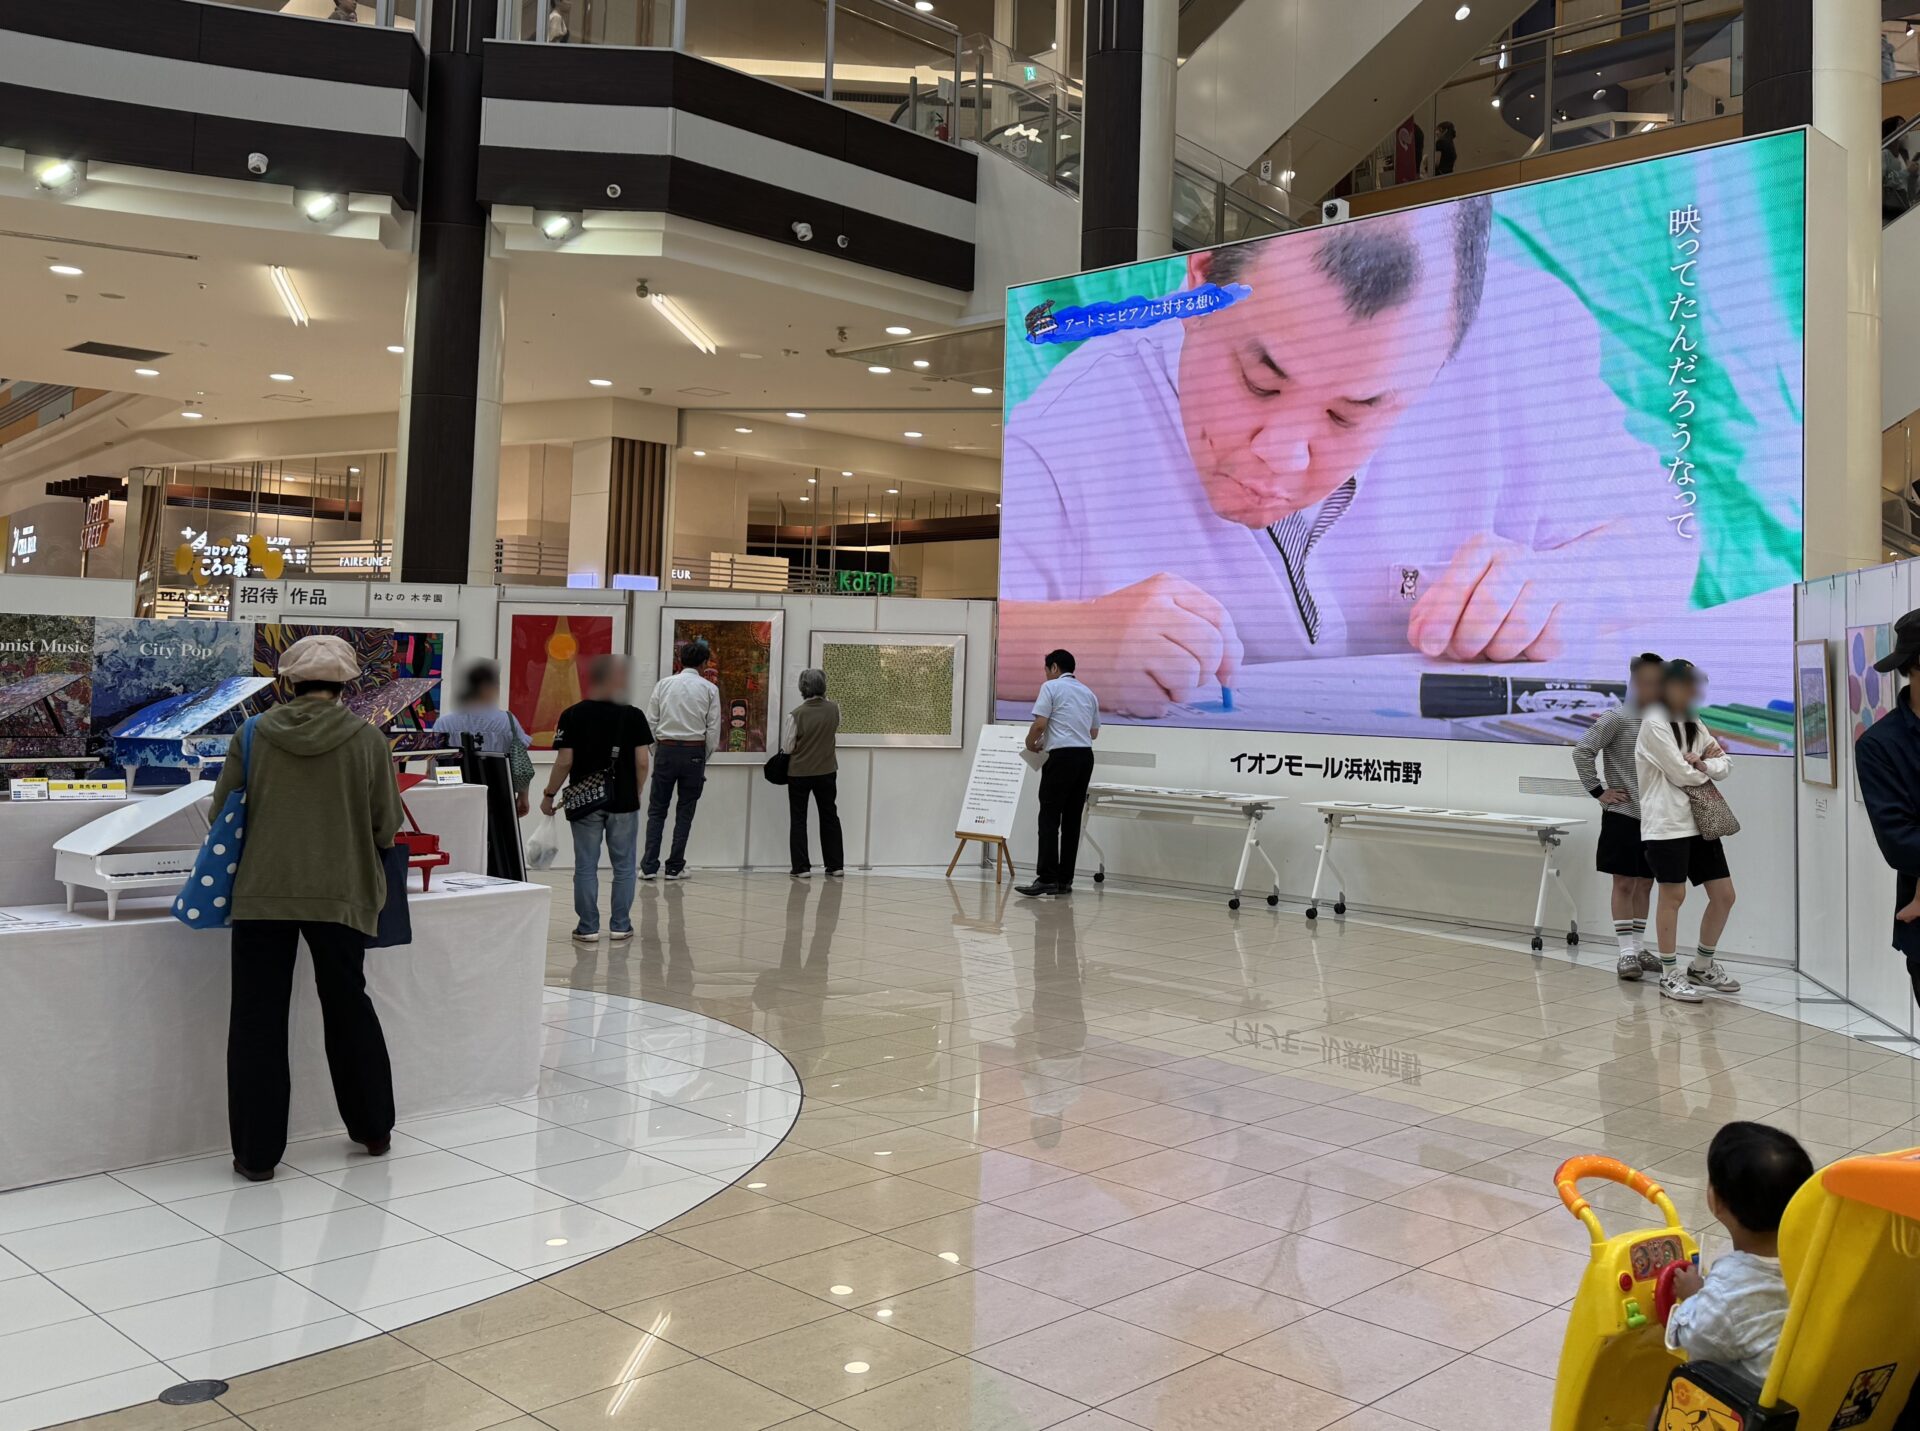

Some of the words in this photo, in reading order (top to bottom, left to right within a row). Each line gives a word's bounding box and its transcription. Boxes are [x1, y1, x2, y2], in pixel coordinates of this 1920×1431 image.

[1065, 294, 1221, 332] アートミニピアノに対する想い
[1666, 203, 1702, 539] 映ってたんだろうなって
[80, 522, 105, 552] STREET
[199, 556, 248, 578] ころっ家
[339, 556, 364, 567] FAIRE
[366, 556, 384, 567] UNE
[671, 569, 692, 580] EUR
[240, 586, 279, 604] 招待
[289, 587, 328, 605] 作品
[40, 639, 89, 654] Music
[139, 642, 176, 658] City
[181, 643, 213, 660] Pop
[1230, 752, 1422, 785] イオンモール浜松市野
